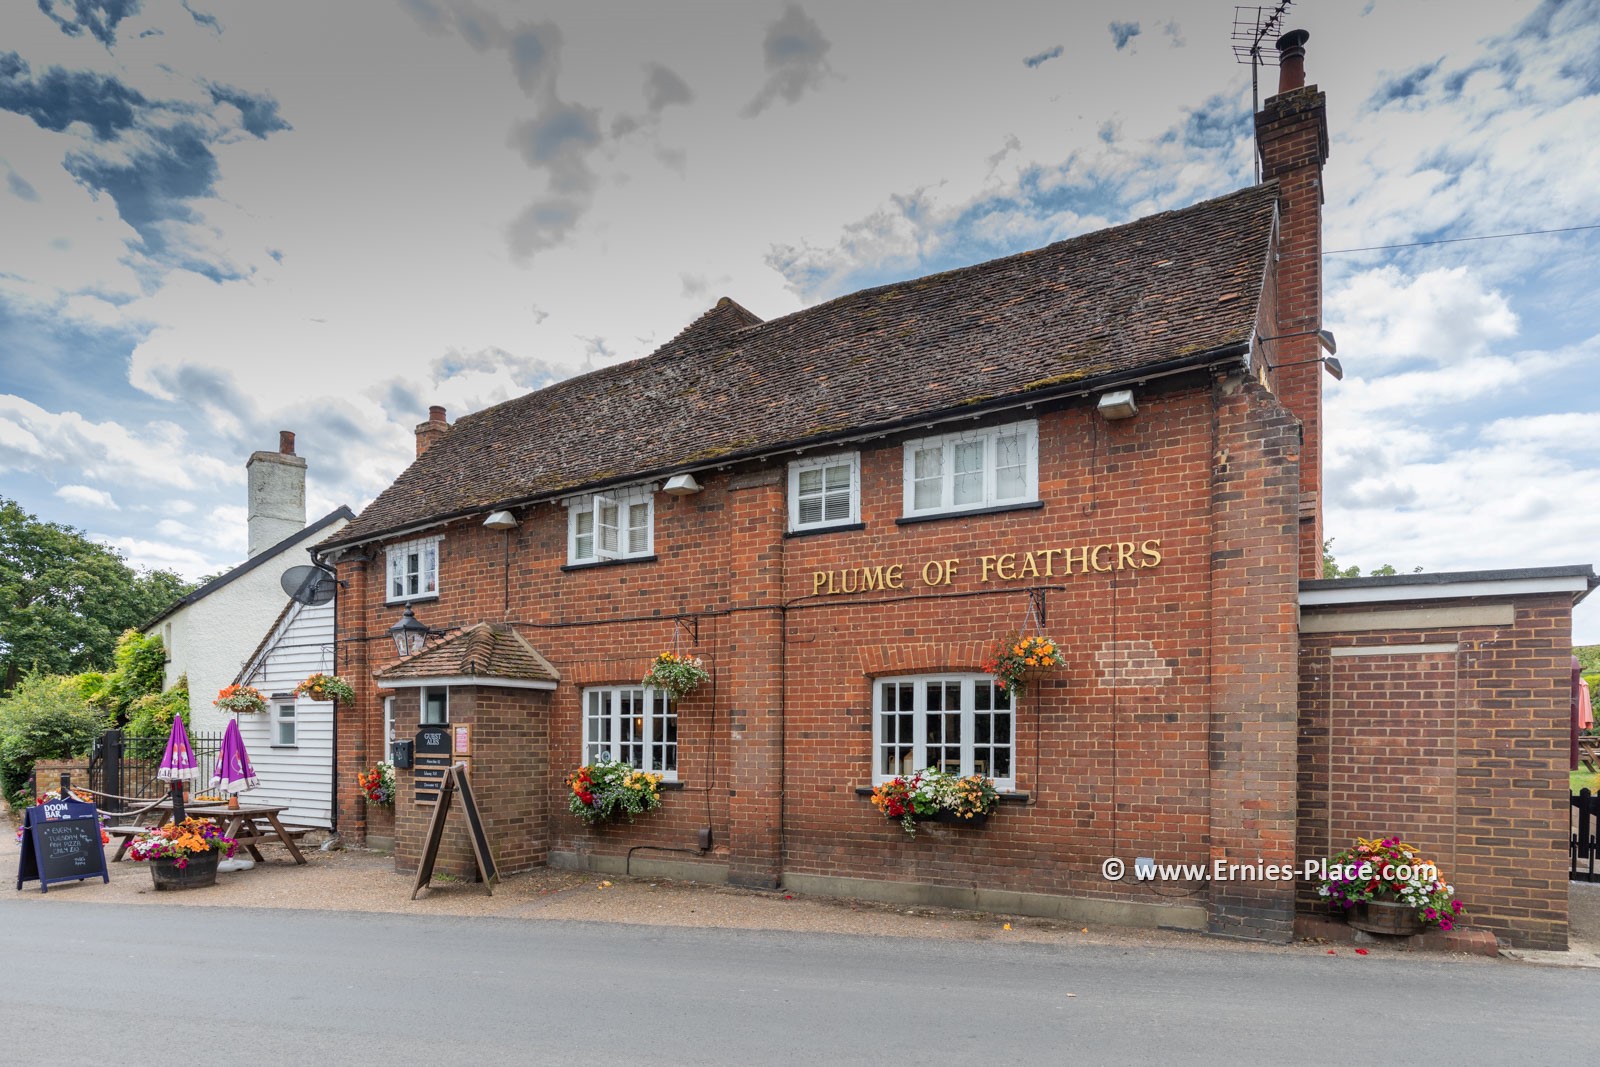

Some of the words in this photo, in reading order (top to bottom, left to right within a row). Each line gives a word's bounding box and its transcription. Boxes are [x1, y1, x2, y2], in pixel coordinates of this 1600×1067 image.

[812, 564, 904, 595] PLUME
[922, 558, 960, 586] OF
[980, 539, 1162, 582] FEATHERS
[48, 834, 78, 842] TUESDAY
